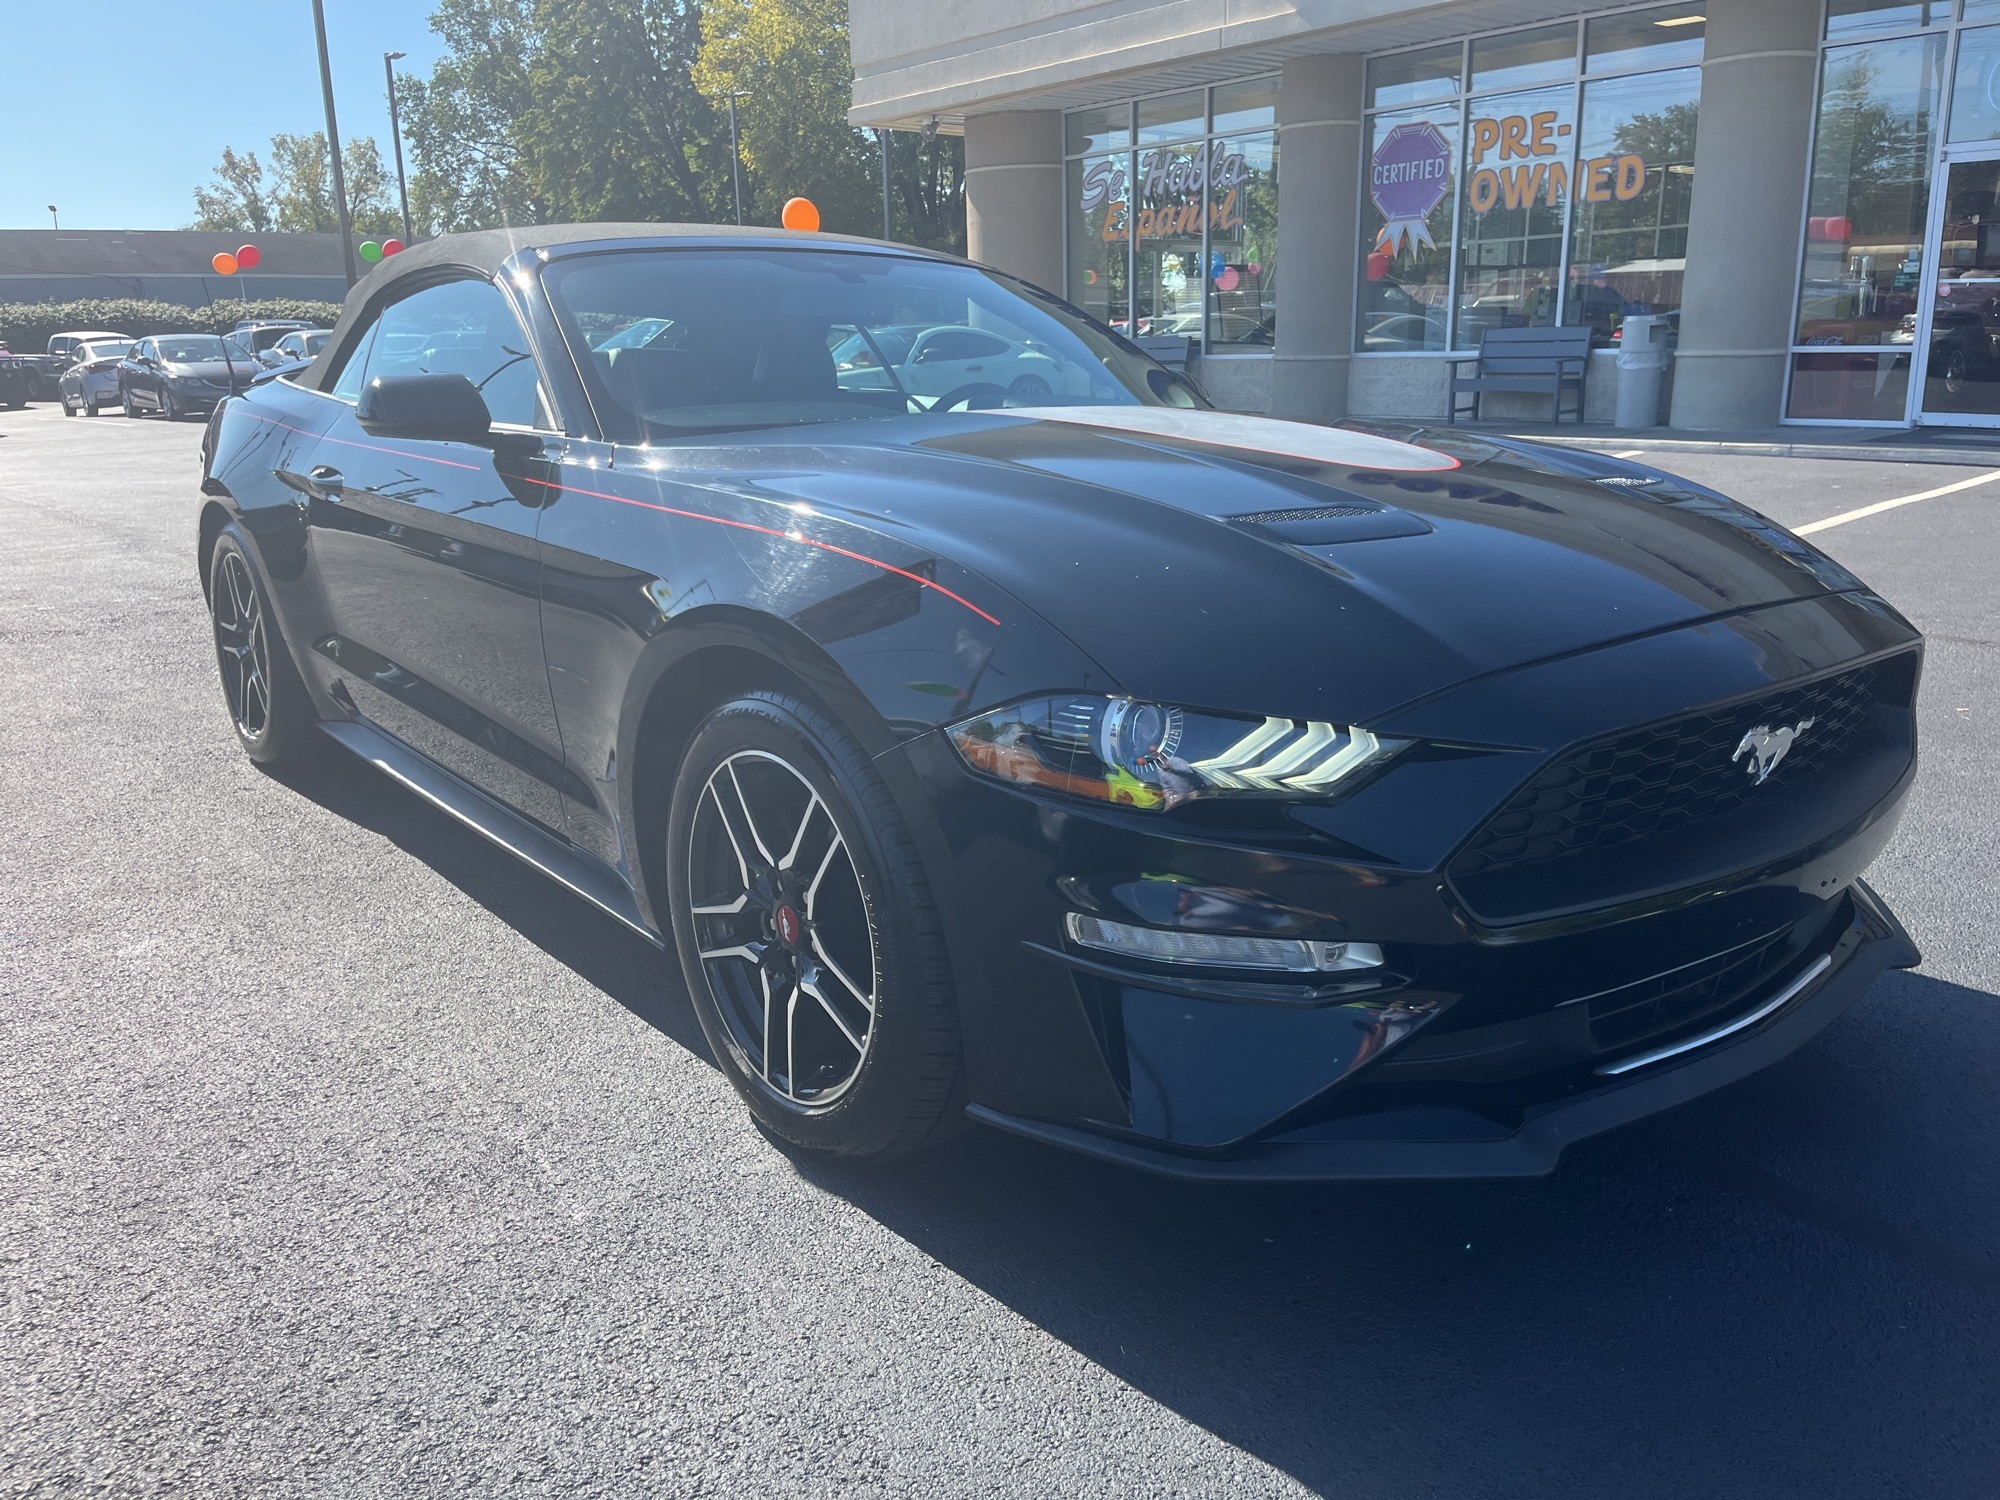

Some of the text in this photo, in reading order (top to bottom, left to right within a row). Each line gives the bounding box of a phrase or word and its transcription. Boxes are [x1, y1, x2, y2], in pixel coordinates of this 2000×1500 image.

[1472, 110, 1572, 165] PRE-
[1080, 141, 1248, 211] Se Habla
[1373, 157, 1446, 186] CERTIFIED
[1470, 154, 1646, 213] OWNED
